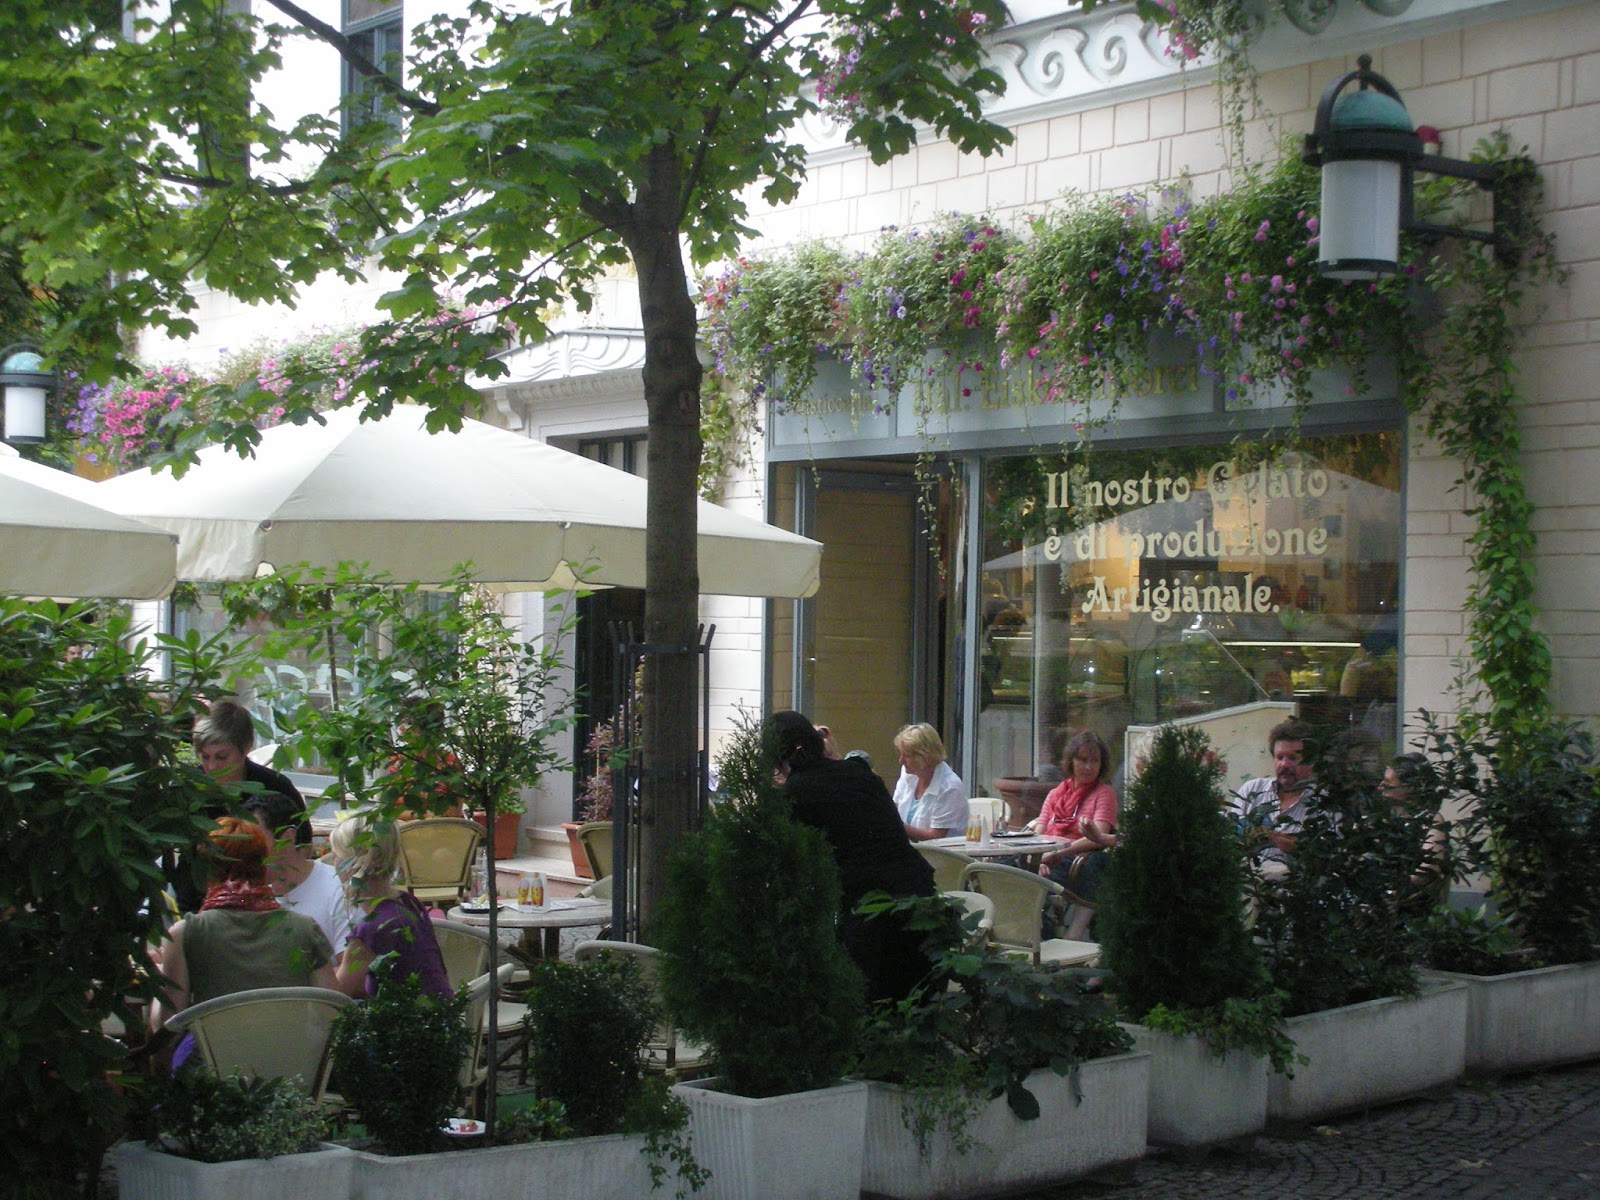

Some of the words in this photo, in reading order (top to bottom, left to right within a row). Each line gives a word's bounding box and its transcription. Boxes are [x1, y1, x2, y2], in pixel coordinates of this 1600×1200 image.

[1045, 471, 1069, 509] Il
[1084, 471, 1190, 507] nostro
[1207, 459, 1328, 499] Gelato
[1044, 527, 1061, 561] è
[1076, 522, 1107, 560] di
[1122, 518, 1328, 567] produzione
[1081, 573, 1280, 623] Artigianale.
